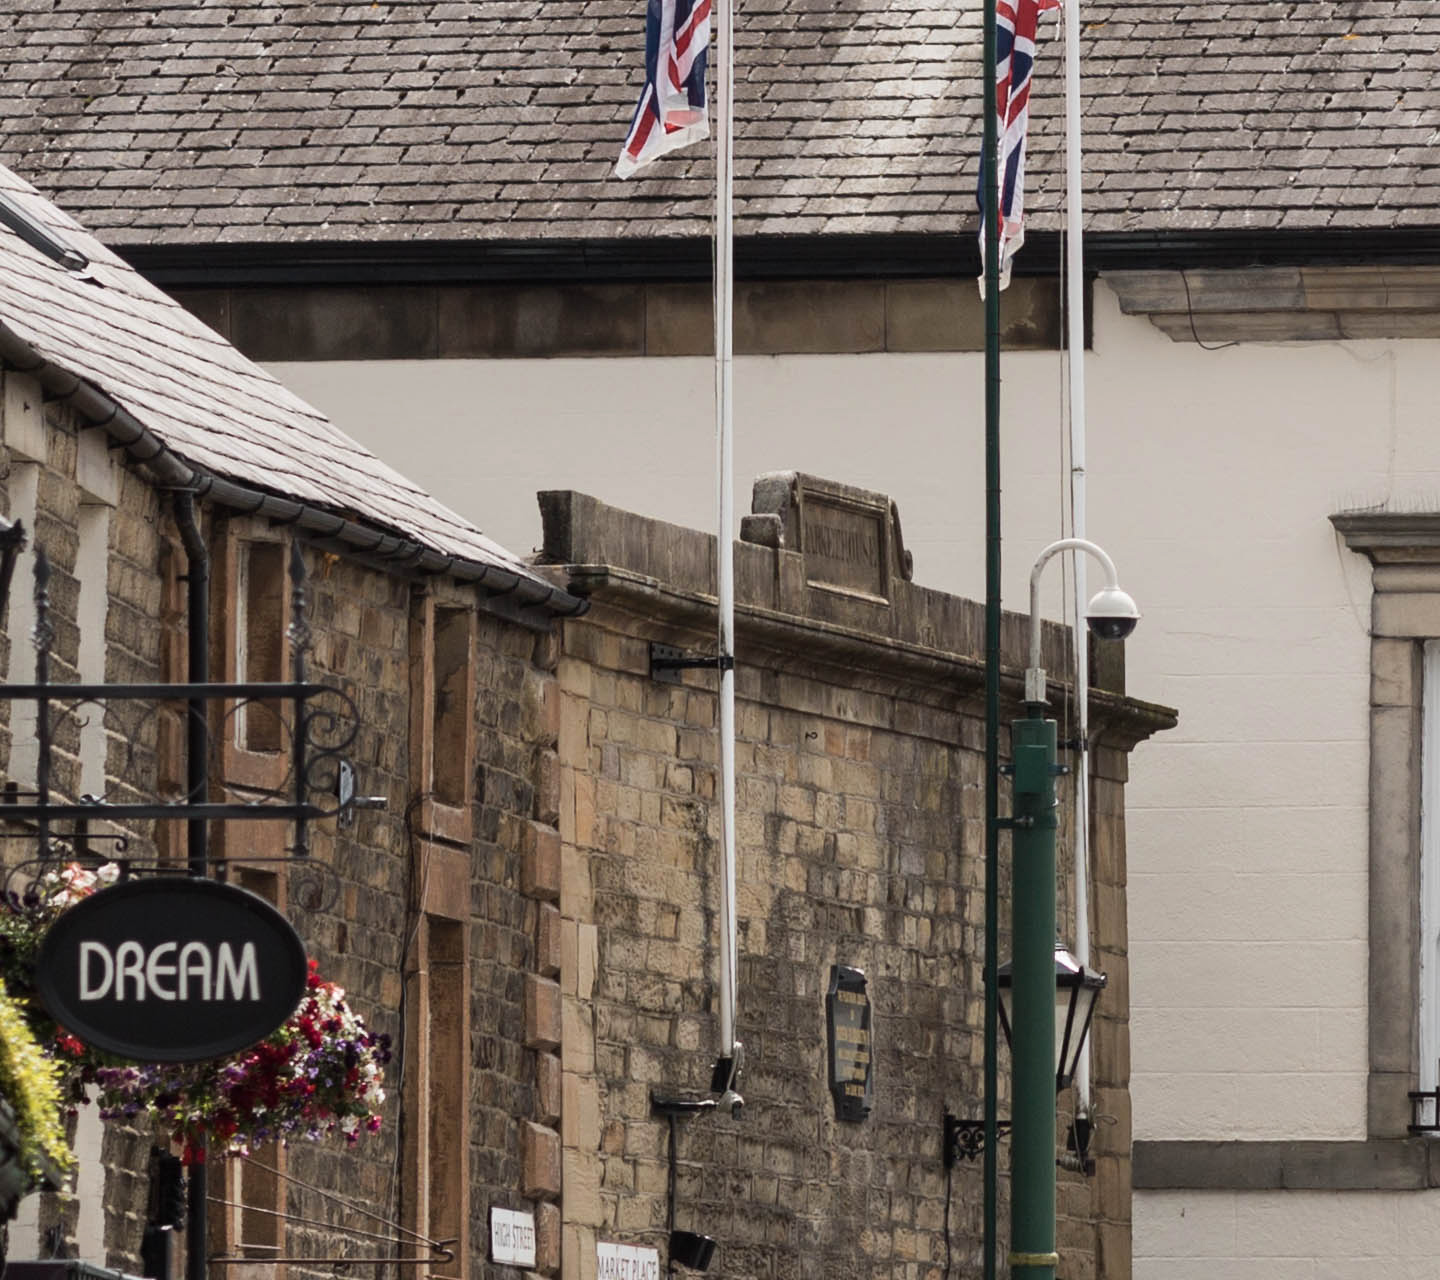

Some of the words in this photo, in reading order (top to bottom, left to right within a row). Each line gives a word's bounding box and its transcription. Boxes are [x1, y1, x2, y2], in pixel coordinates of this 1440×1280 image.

[79, 940, 261, 1001] DREAM
[494, 1221, 511, 1248] HIGH
[512, 1224, 533, 1251] STREET
